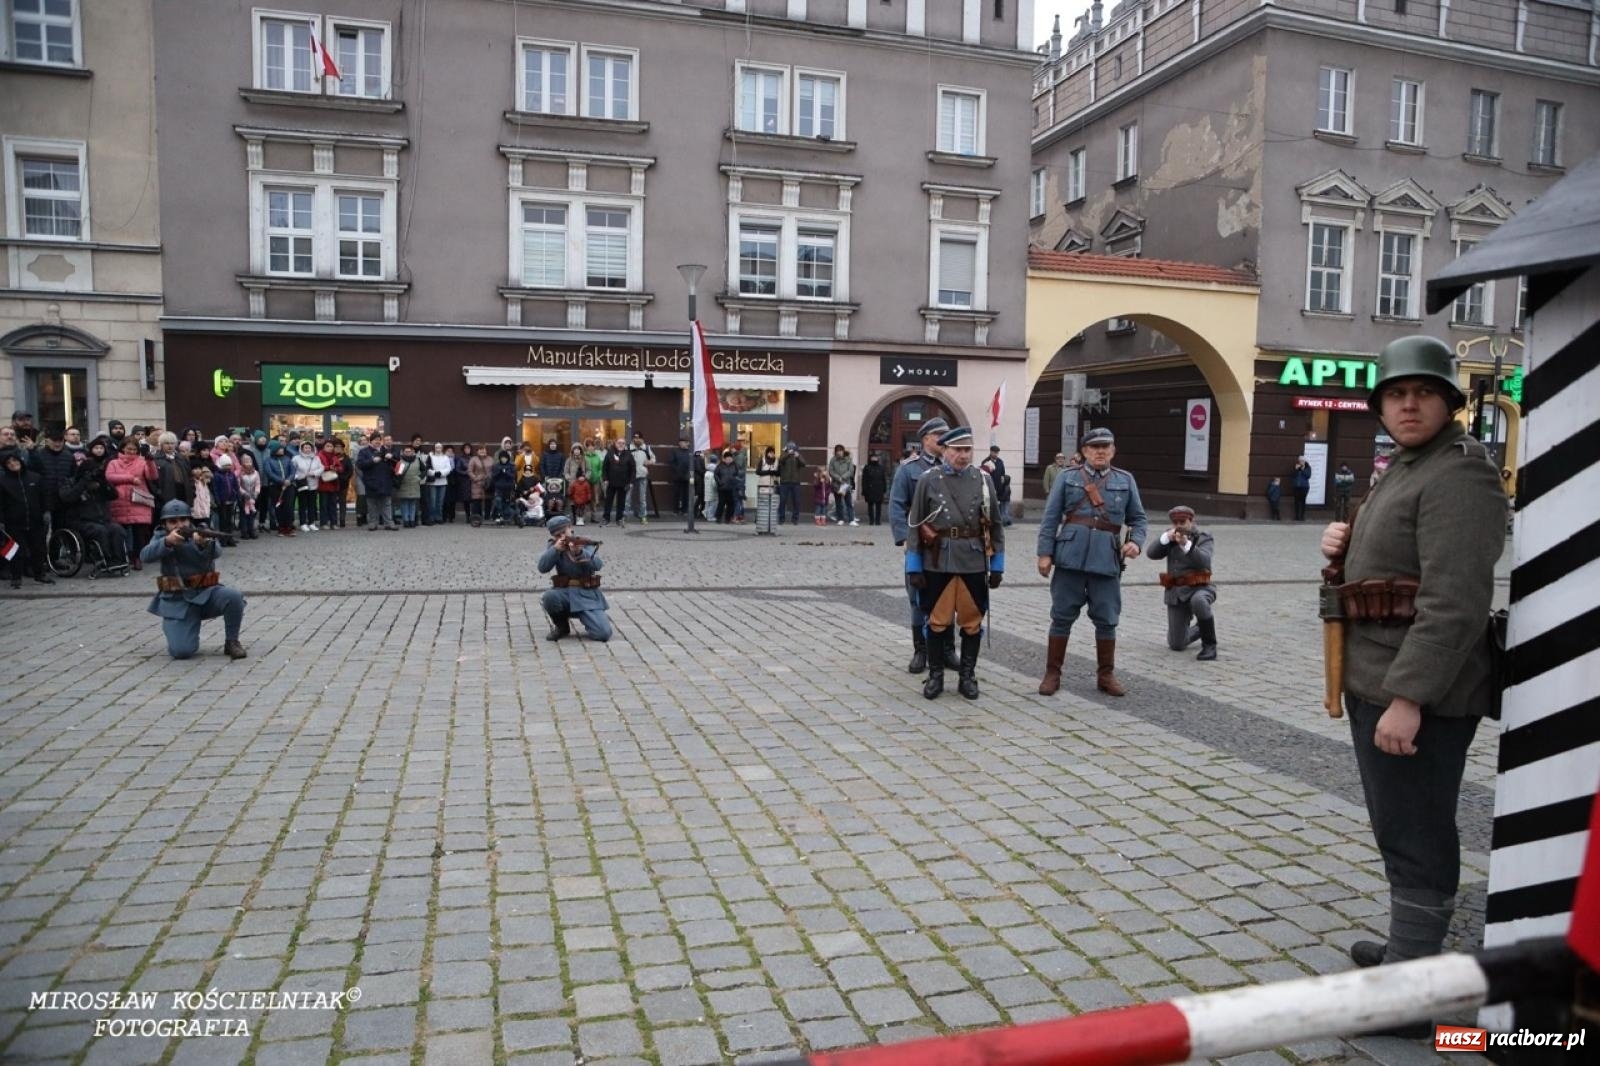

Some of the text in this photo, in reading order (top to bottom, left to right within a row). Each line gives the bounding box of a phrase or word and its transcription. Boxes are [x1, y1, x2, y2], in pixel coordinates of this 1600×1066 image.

[527, 345, 785, 374] Manufaktura Lodó Gałeczka
[279, 372, 373, 398] żabka
